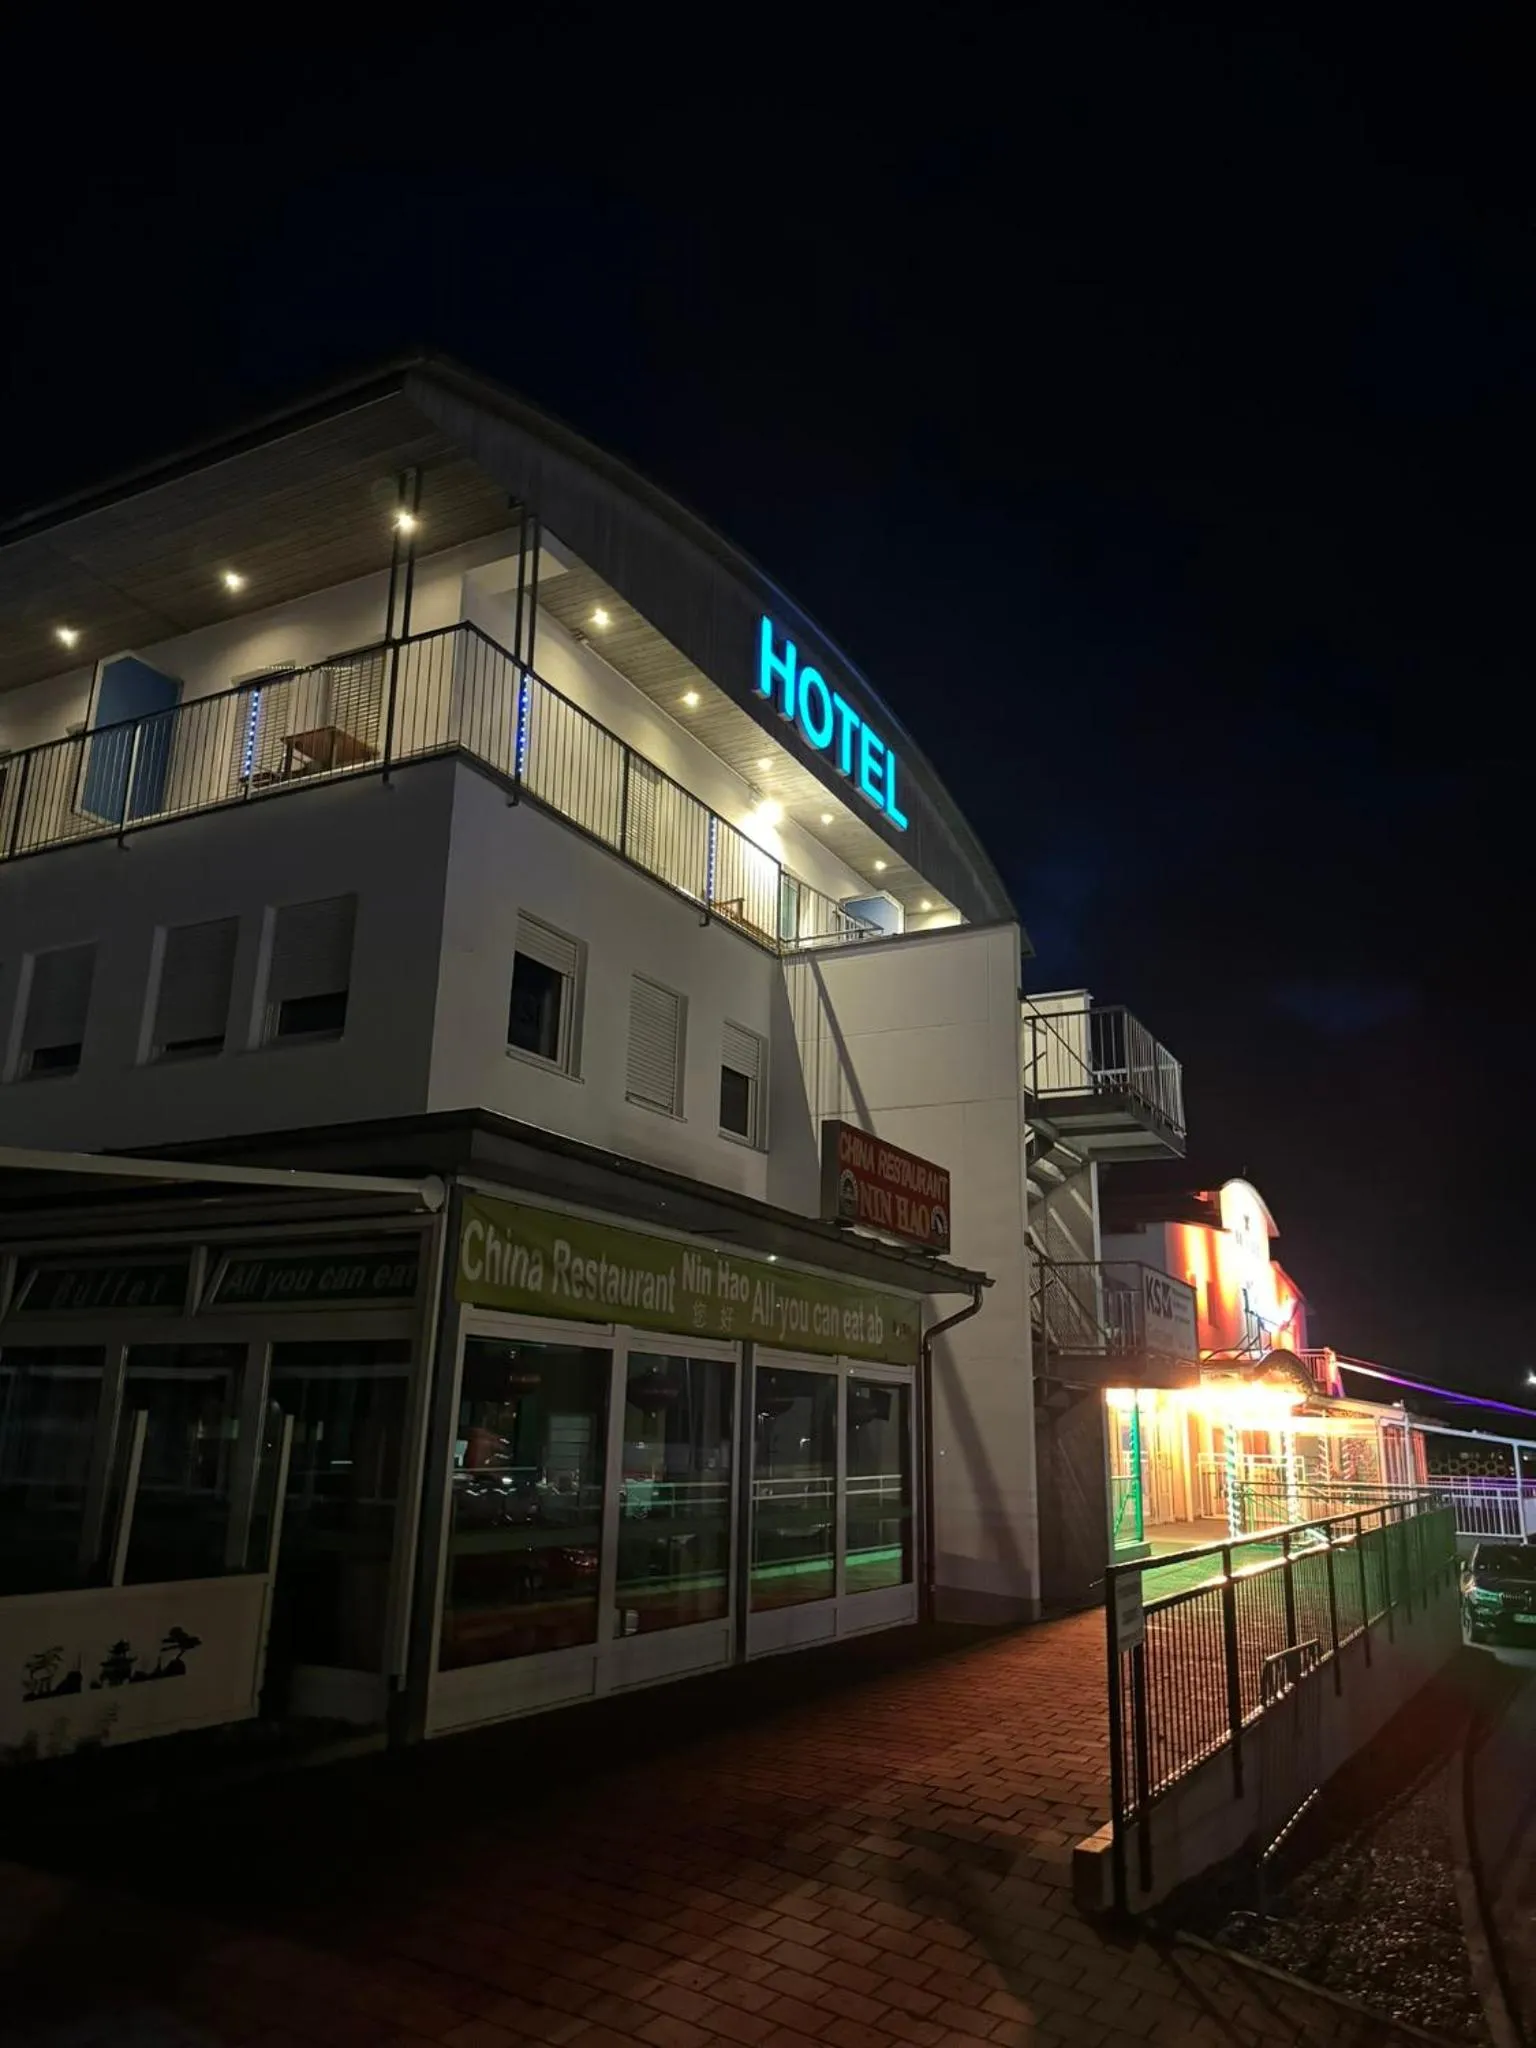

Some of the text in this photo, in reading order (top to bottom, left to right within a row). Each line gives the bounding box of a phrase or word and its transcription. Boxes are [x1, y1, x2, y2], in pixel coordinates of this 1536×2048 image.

[759, 615, 908, 830] HOTEL
[840, 1131, 949, 1202] CHINA RESTAURANT
[859, 1181, 931, 1239] NIN HAO
[223, 1262, 263, 1296] All
[263, 1267, 313, 1300] you
[318, 1265, 366, 1290] can
[462, 1218, 676, 1314] China Restaurant
[682, 1250, 749, 1303] Nin Hao
[751, 1279, 776, 1328] All
[778, 1295, 809, 1342] you
[813, 1301, 840, 1337] can
[843, 1304, 866, 1342] eat
[867, 1305, 884, 1345] ab
